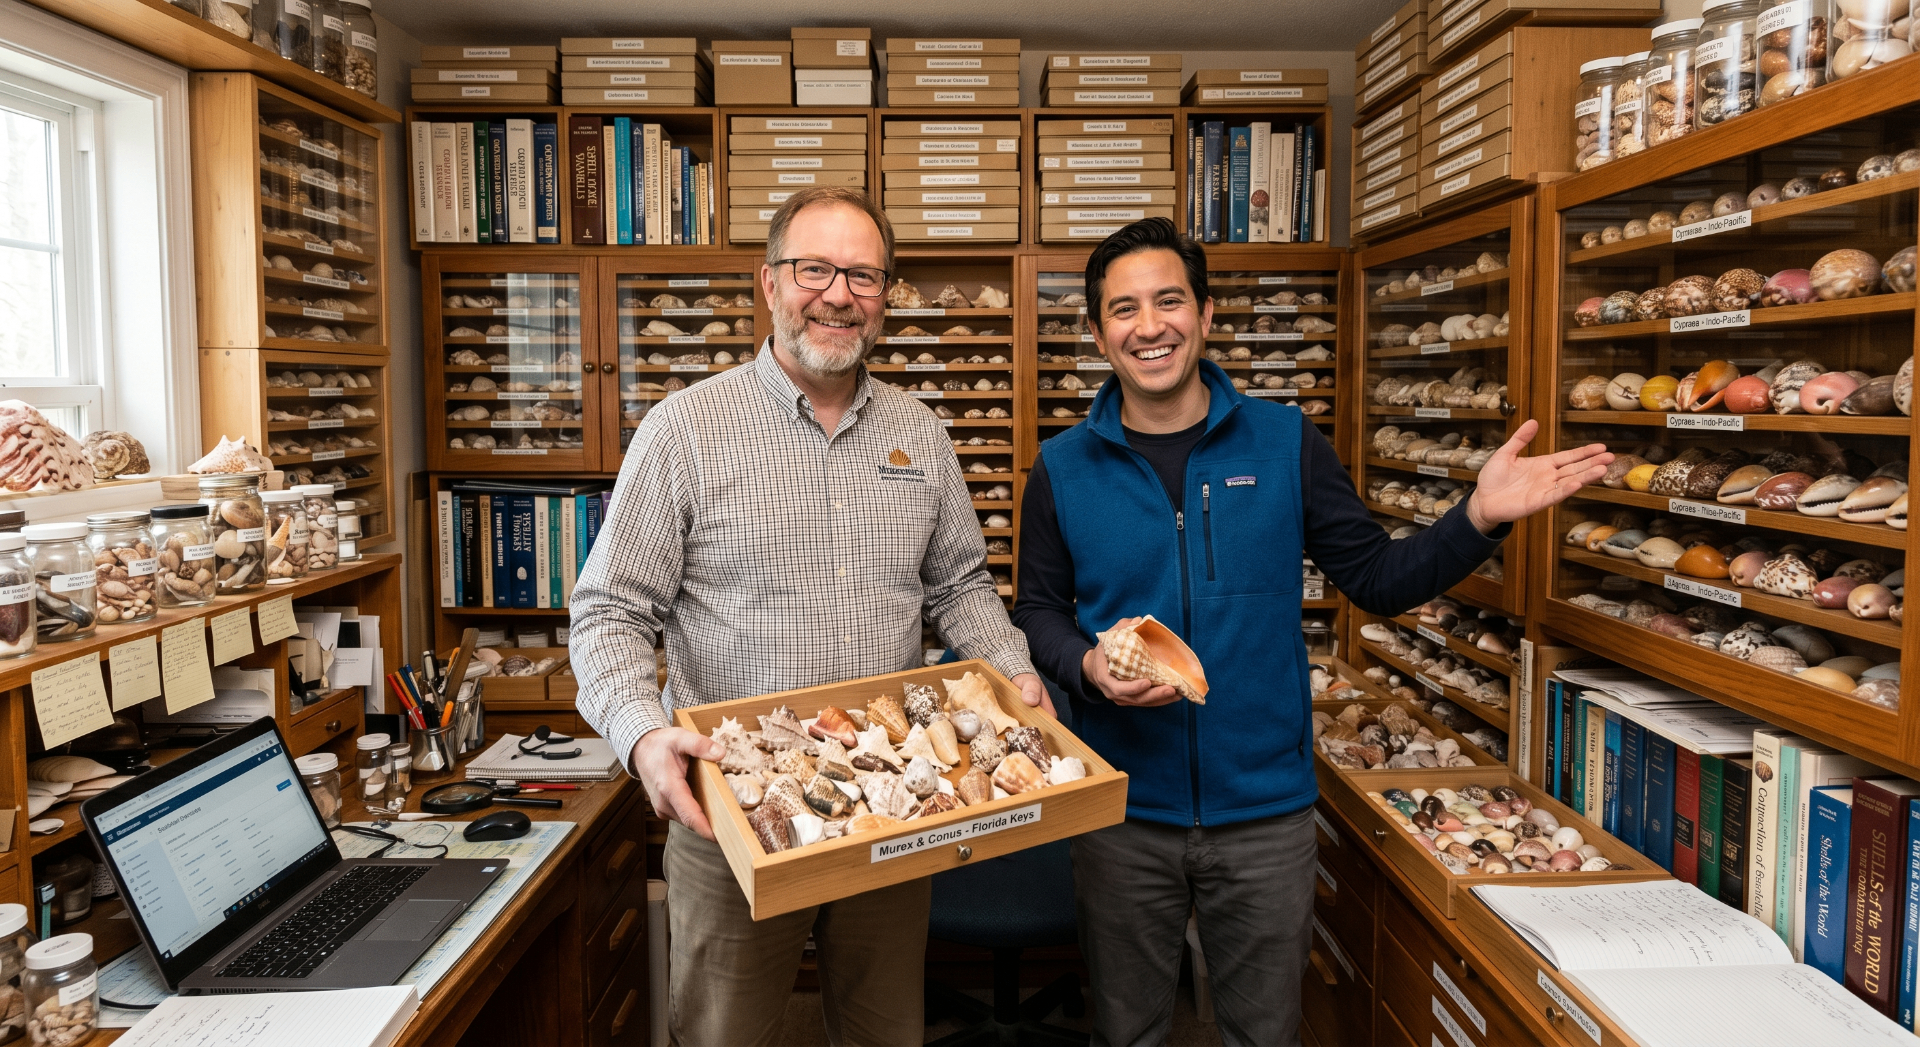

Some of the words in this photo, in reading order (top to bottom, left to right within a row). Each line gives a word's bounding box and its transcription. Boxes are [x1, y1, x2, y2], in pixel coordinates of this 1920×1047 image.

[879, 841, 914, 856] Murex
[915, 836, 926, 848] &
[927, 827, 963, 845] Conus
[971, 818, 1007, 834] Florida
[1010, 811, 1035, 825] Keys
[1818, 868, 1831, 887] of
[1818, 883, 1831, 902] the
[1817, 902, 1829, 939] World
[1863, 934, 1882, 995] WORLD
